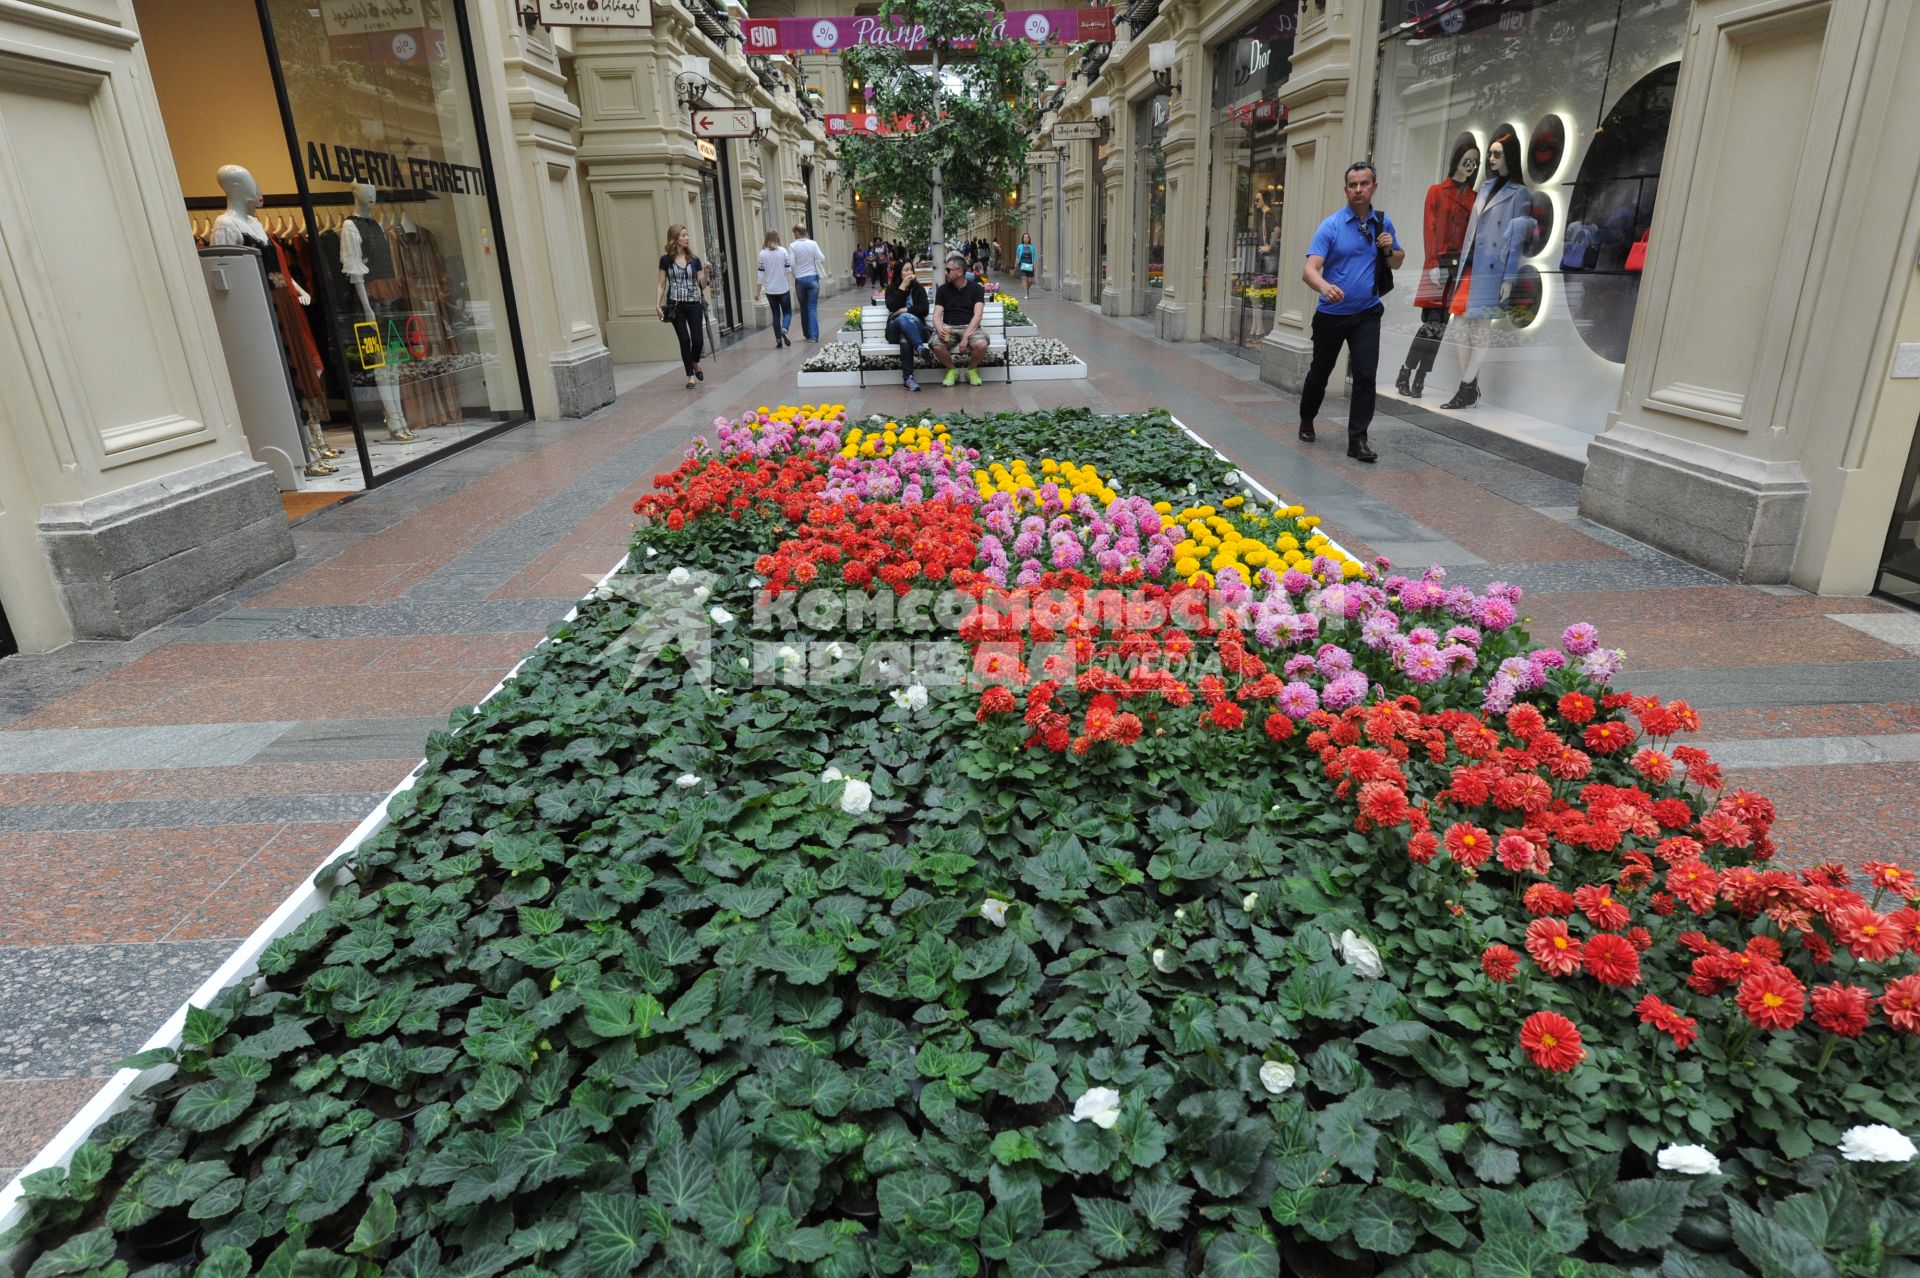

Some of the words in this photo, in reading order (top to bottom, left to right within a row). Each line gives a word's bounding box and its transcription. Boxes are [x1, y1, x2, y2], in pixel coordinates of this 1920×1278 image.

[579, 15, 610, 23] FAMILY
[1249, 40, 1271, 75] Dior
[307, 141, 405, 188] ALBERTA
[408, 157, 485, 196] FERRETTI
